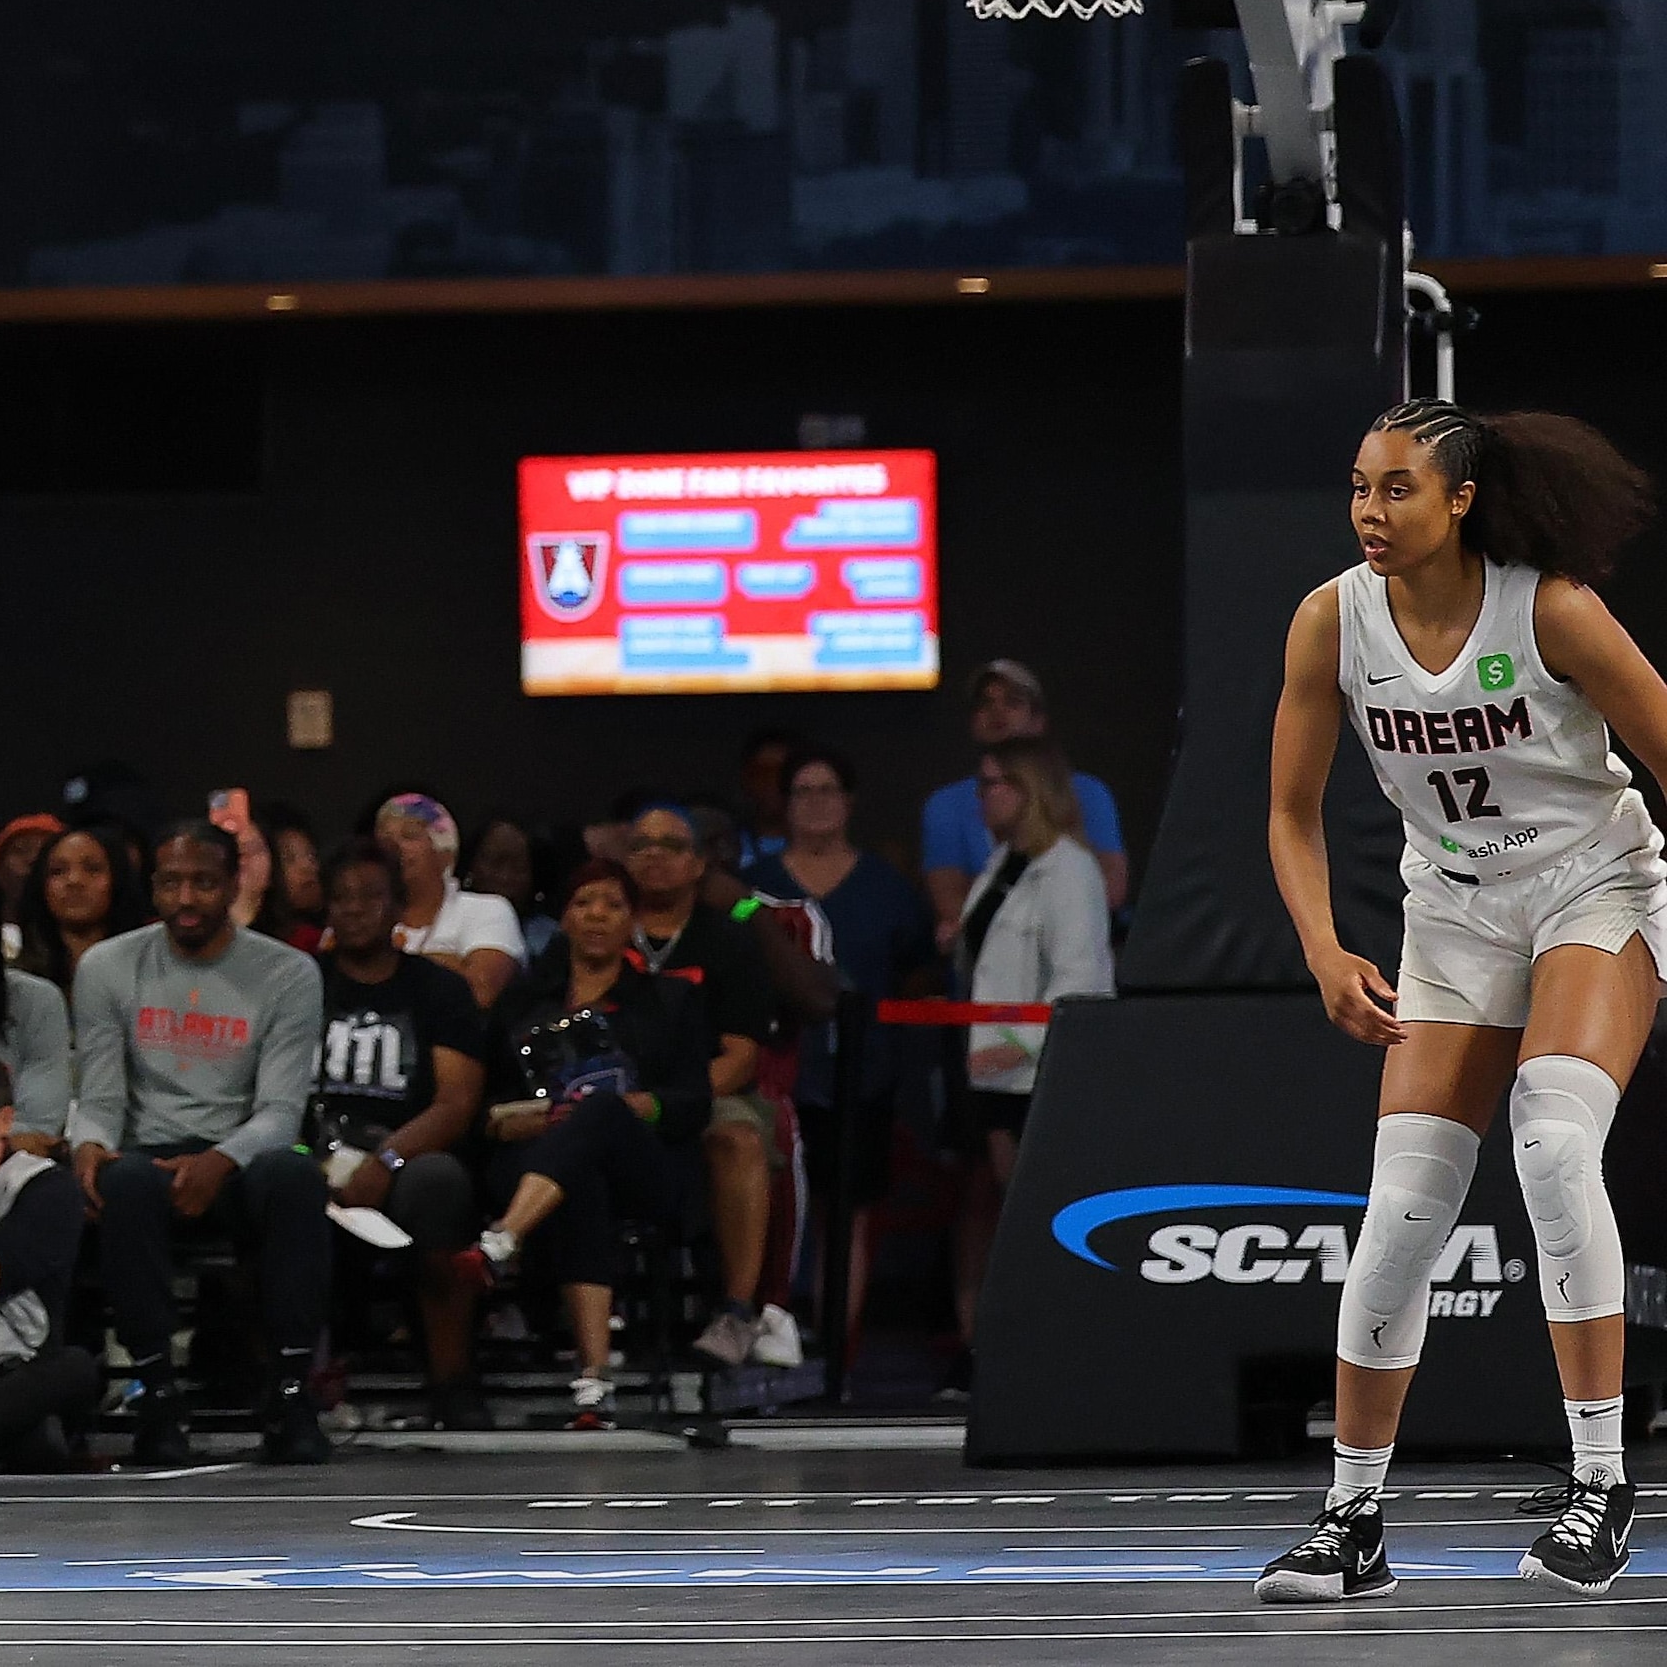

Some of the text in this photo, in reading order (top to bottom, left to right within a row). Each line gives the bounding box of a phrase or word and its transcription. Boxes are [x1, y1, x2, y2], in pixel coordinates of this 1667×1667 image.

[1365, 696, 1534, 755] DREAM
[1427, 766, 1502, 823] 12
[1466, 827, 1539, 859] ash App
[1139, 1223, 1504, 1285] SCAA
[1429, 1289, 1504, 1318] RGY
